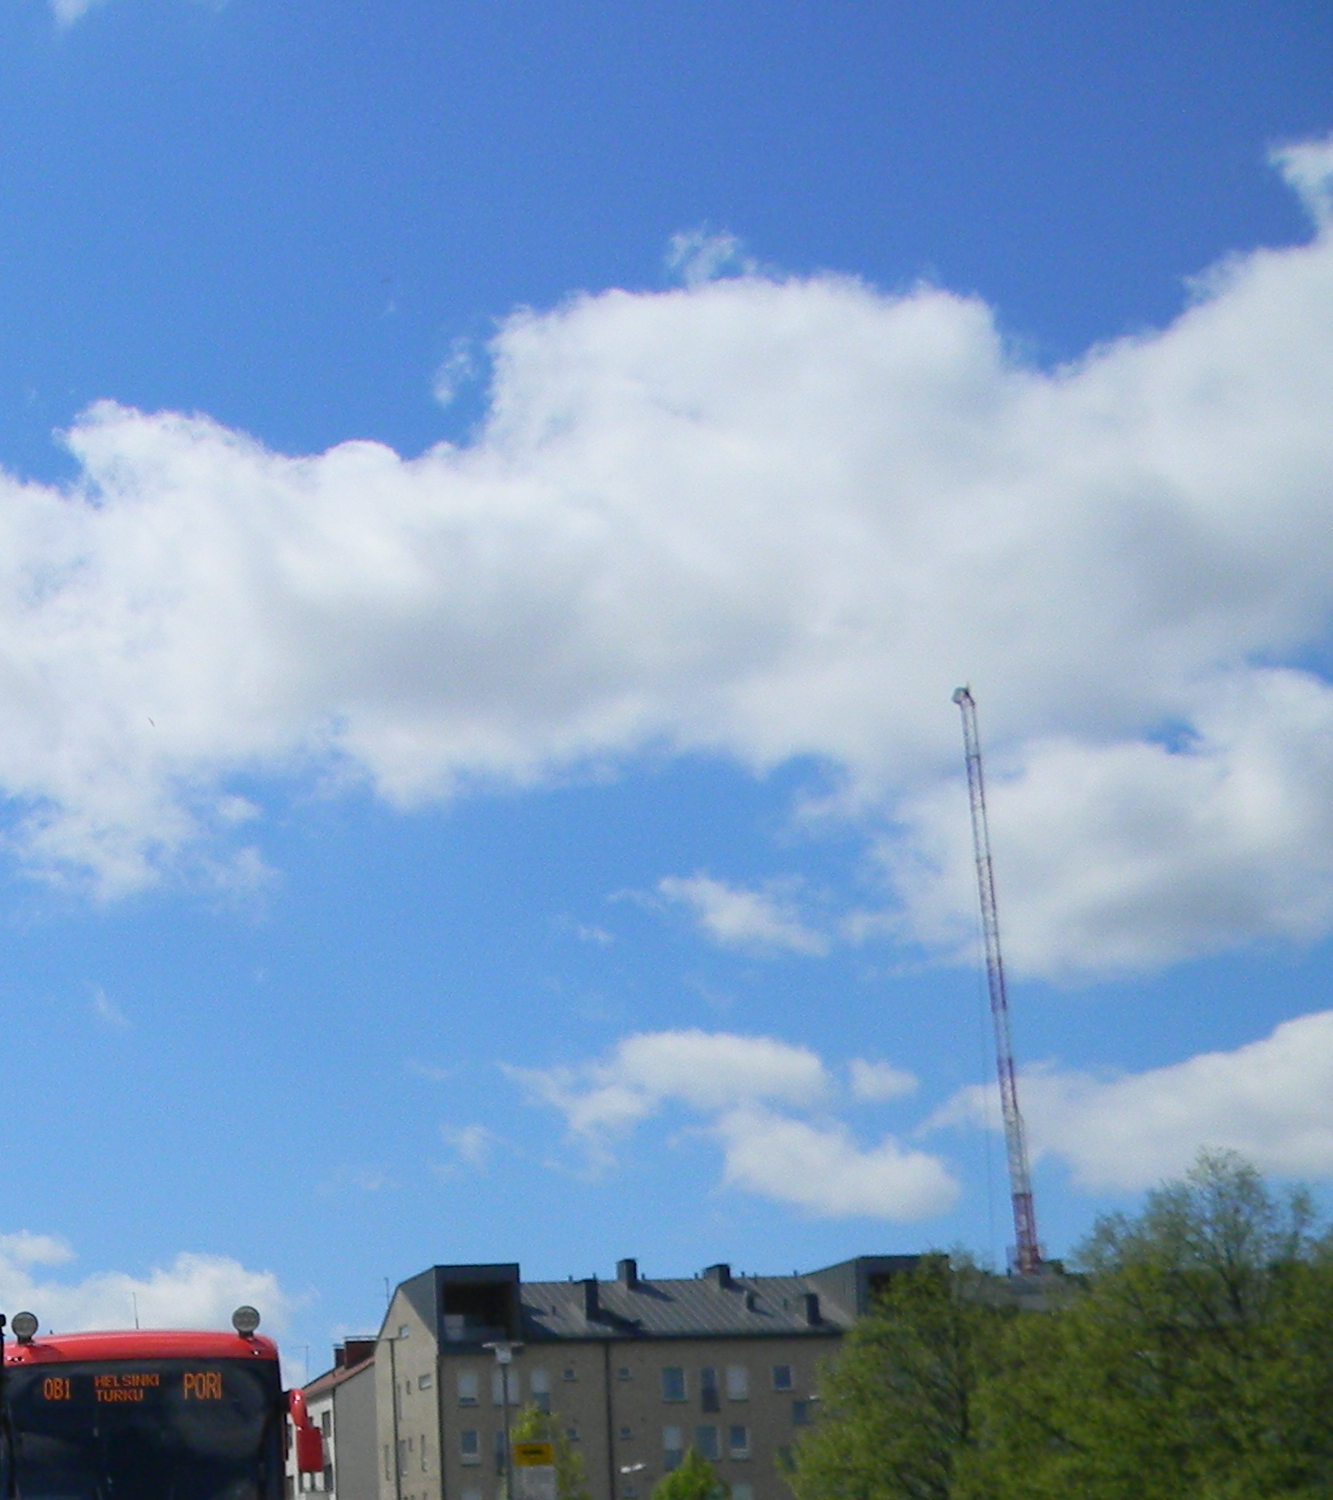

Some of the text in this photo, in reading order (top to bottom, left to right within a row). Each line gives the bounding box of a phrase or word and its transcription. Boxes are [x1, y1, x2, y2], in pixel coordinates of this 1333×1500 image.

[94, 1373, 161, 1388] HELSINKI
[184, 1371, 222, 1400] PORI
[95, 1388, 144, 1402] TURKU
